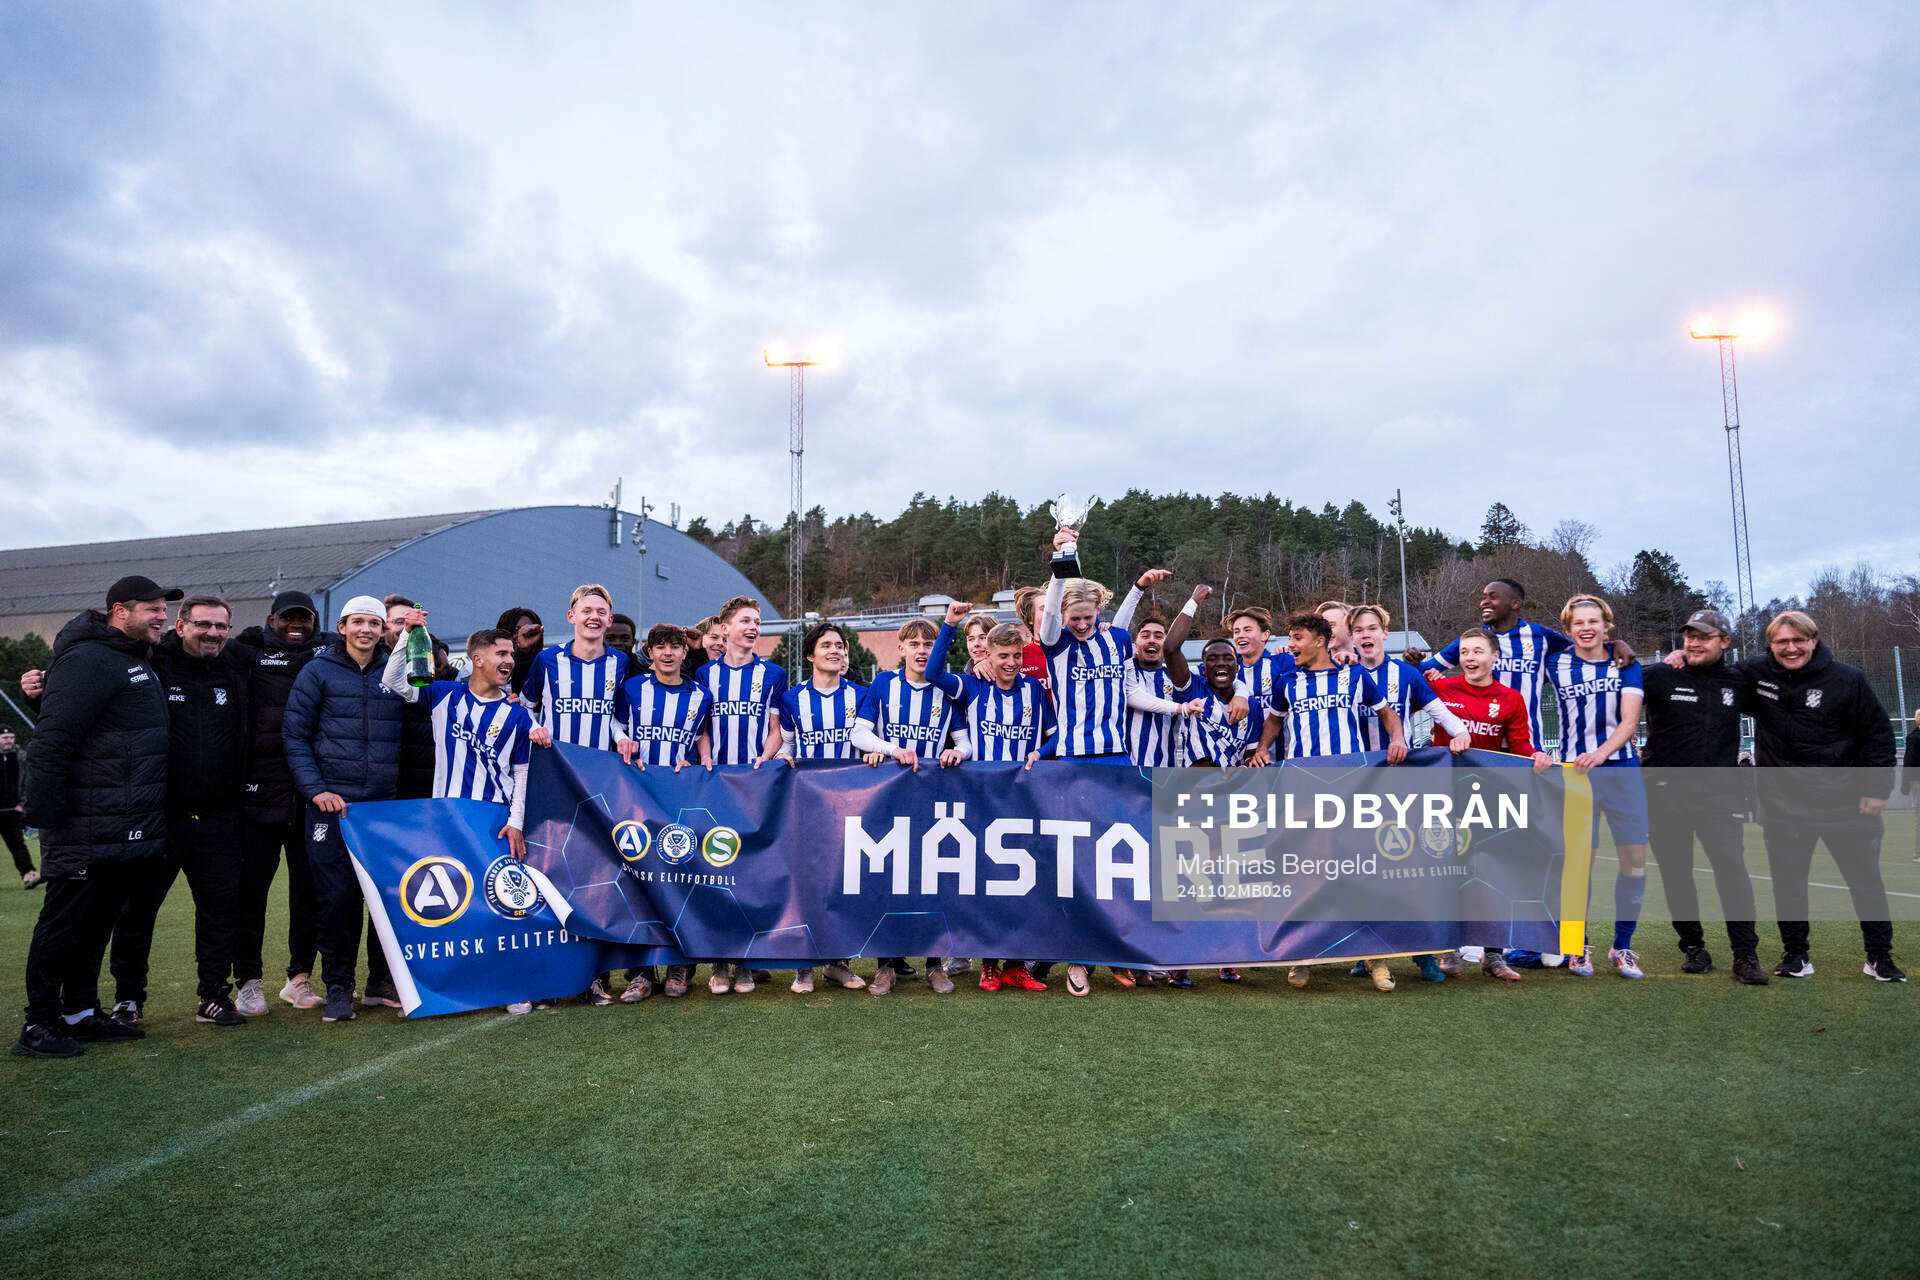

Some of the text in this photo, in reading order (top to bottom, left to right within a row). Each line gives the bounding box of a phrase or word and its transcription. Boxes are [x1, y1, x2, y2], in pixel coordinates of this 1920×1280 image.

[1071, 665, 1124, 681] SERNEKE
[1492, 658, 1537, 674] RNEKE
[1558, 678, 1623, 700] SERNEKE
[1293, 694, 1351, 714] SERNEKE
[636, 726, 693, 746] SERNEKE
[886, 723, 942, 742] SERNEKE
[980, 720, 1033, 740] SERNEKE
[1464, 720, 1501, 736] RNEKE
[128, 830, 142, 840] LG
[843, 802, 1273, 902] MÄSTARE
[661, 872, 736, 886] ELITFOTBOLL
[1382, 866, 1424, 880] SVENSK
[404, 938, 485, 961] SVENSK
